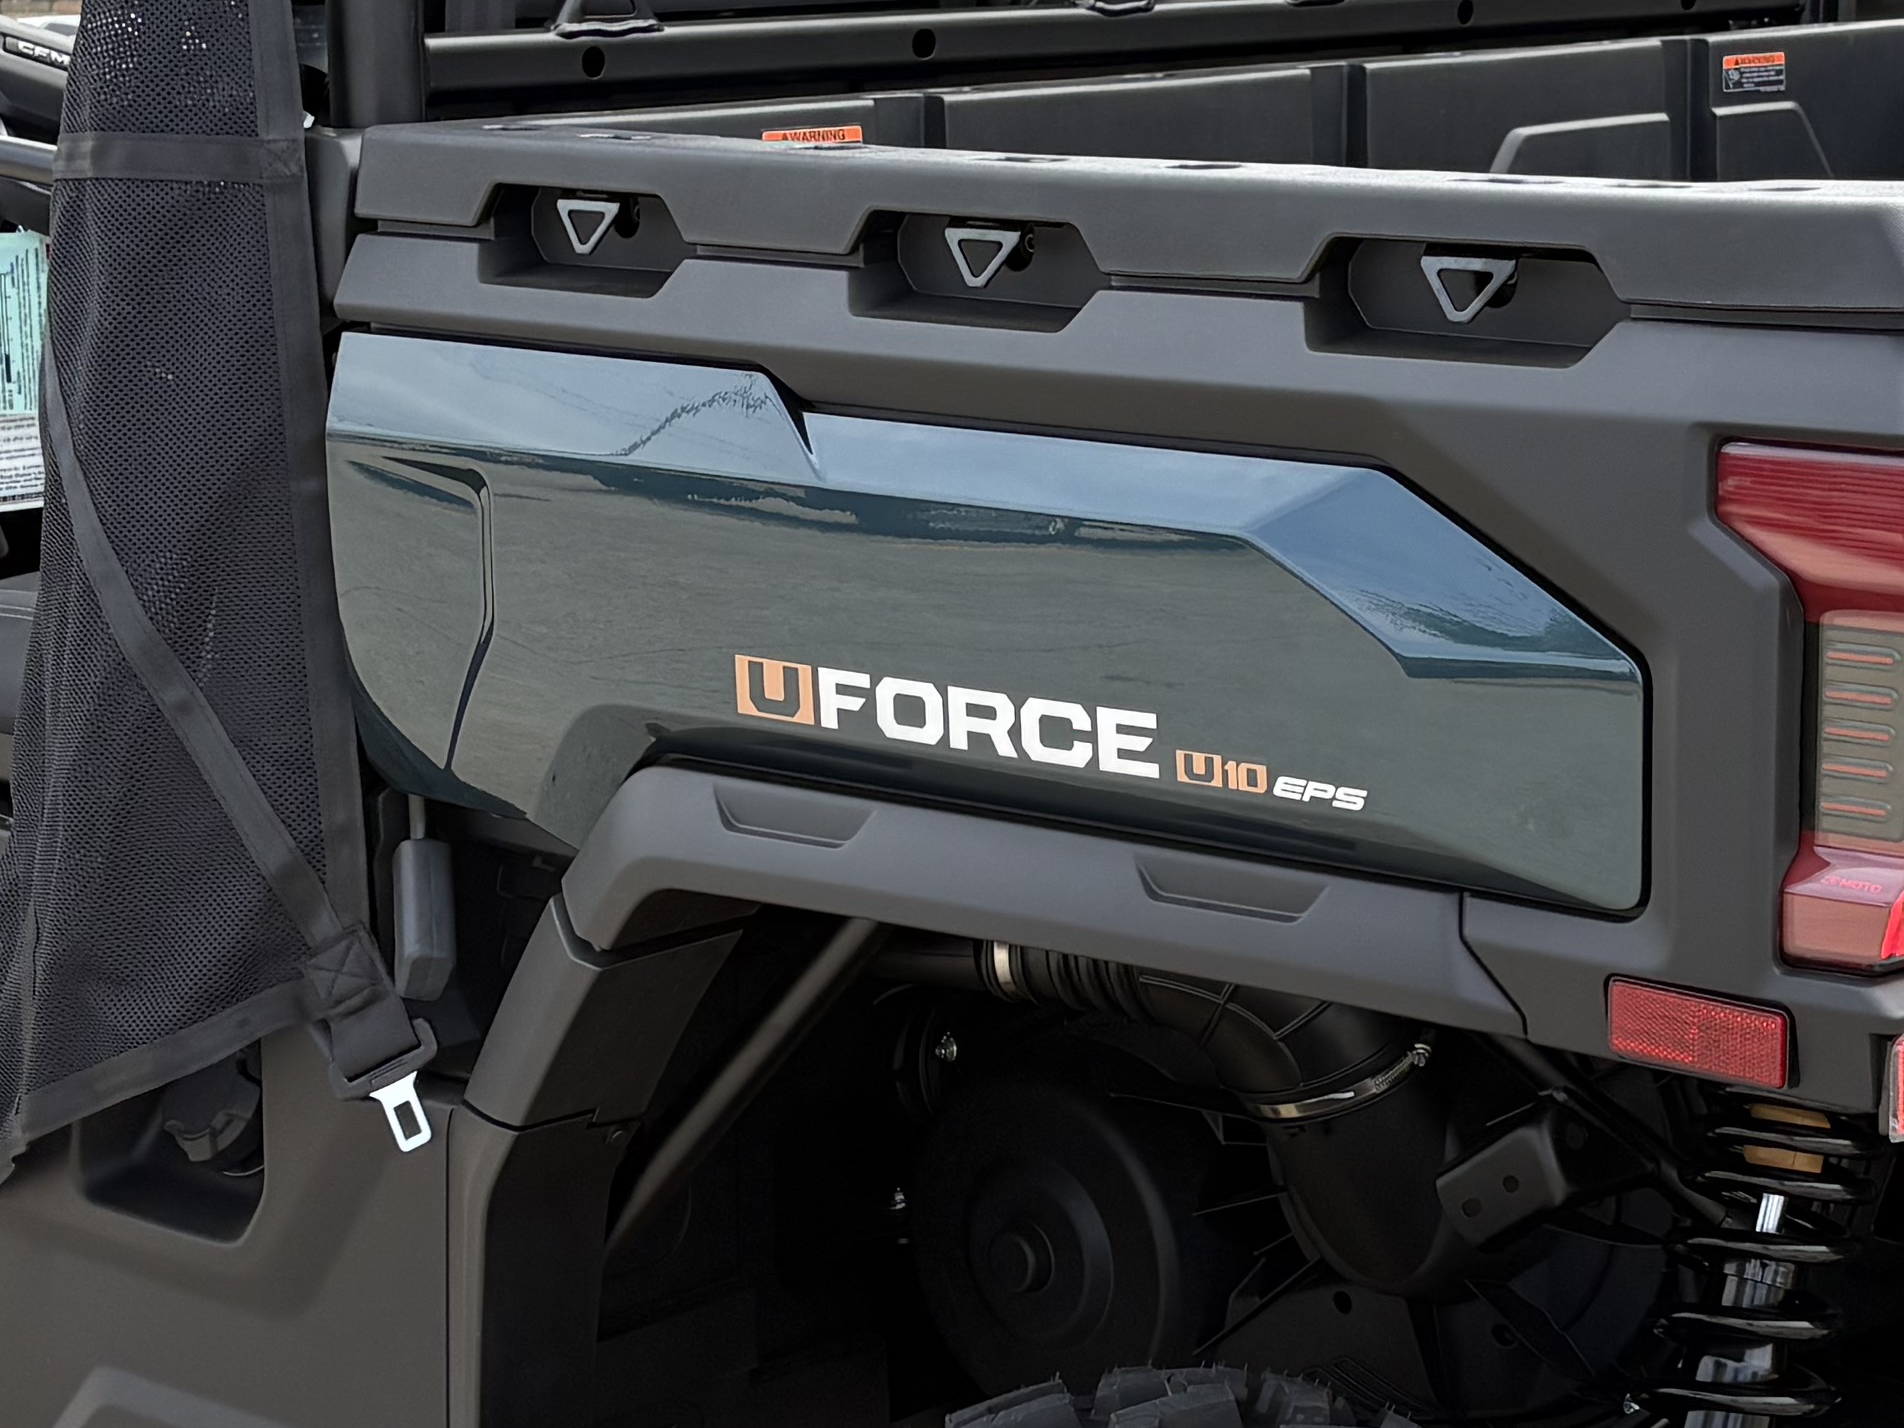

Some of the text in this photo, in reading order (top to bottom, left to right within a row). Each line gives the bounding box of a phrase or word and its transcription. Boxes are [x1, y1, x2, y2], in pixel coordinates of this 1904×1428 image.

[788, 128, 846, 143] WARNING
[1176, 748, 1268, 795] U10
[1273, 775, 1368, 811] EPS
